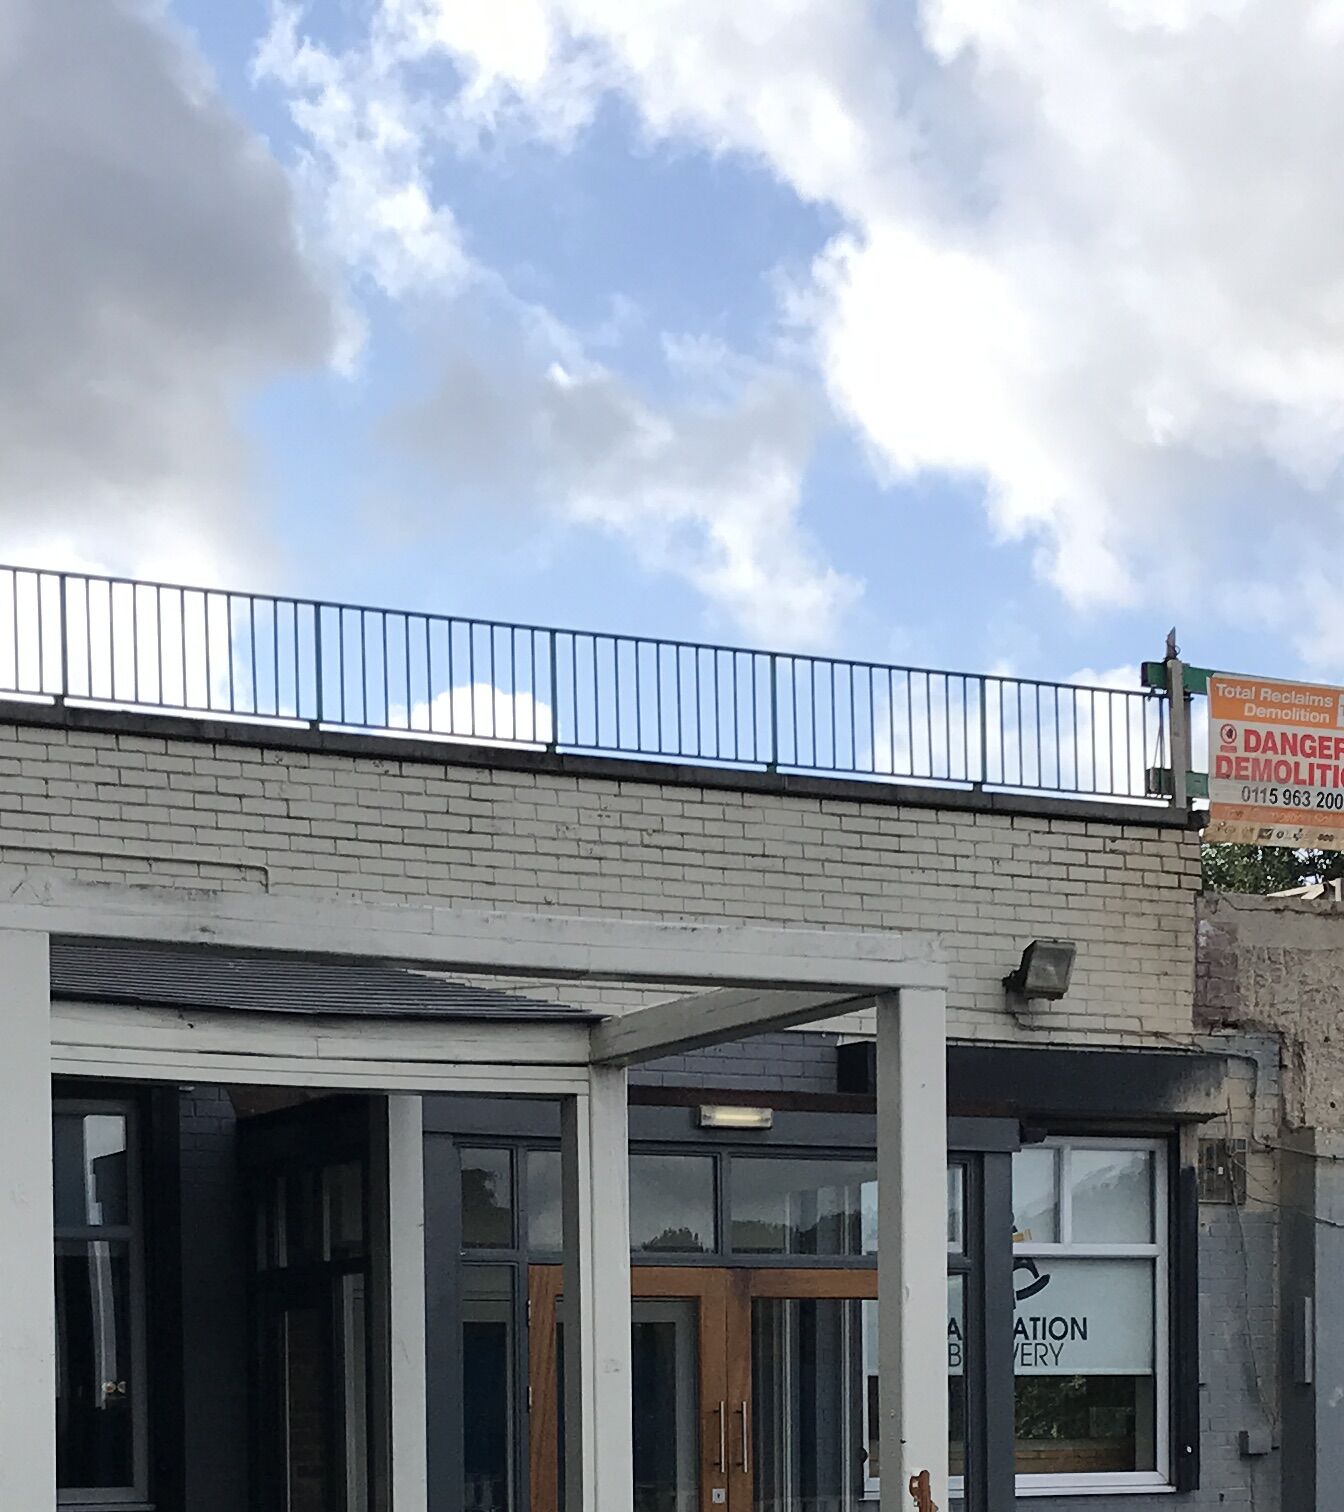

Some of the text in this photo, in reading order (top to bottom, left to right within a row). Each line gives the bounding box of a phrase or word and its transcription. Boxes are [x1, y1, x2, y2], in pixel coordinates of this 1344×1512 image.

[1216, 683, 1334, 708] Total Reclaims
[1244, 703, 1330, 724] Demolition
[1241, 786, 1278, 804] 0115
[1282, 789, 1311, 807] 963
